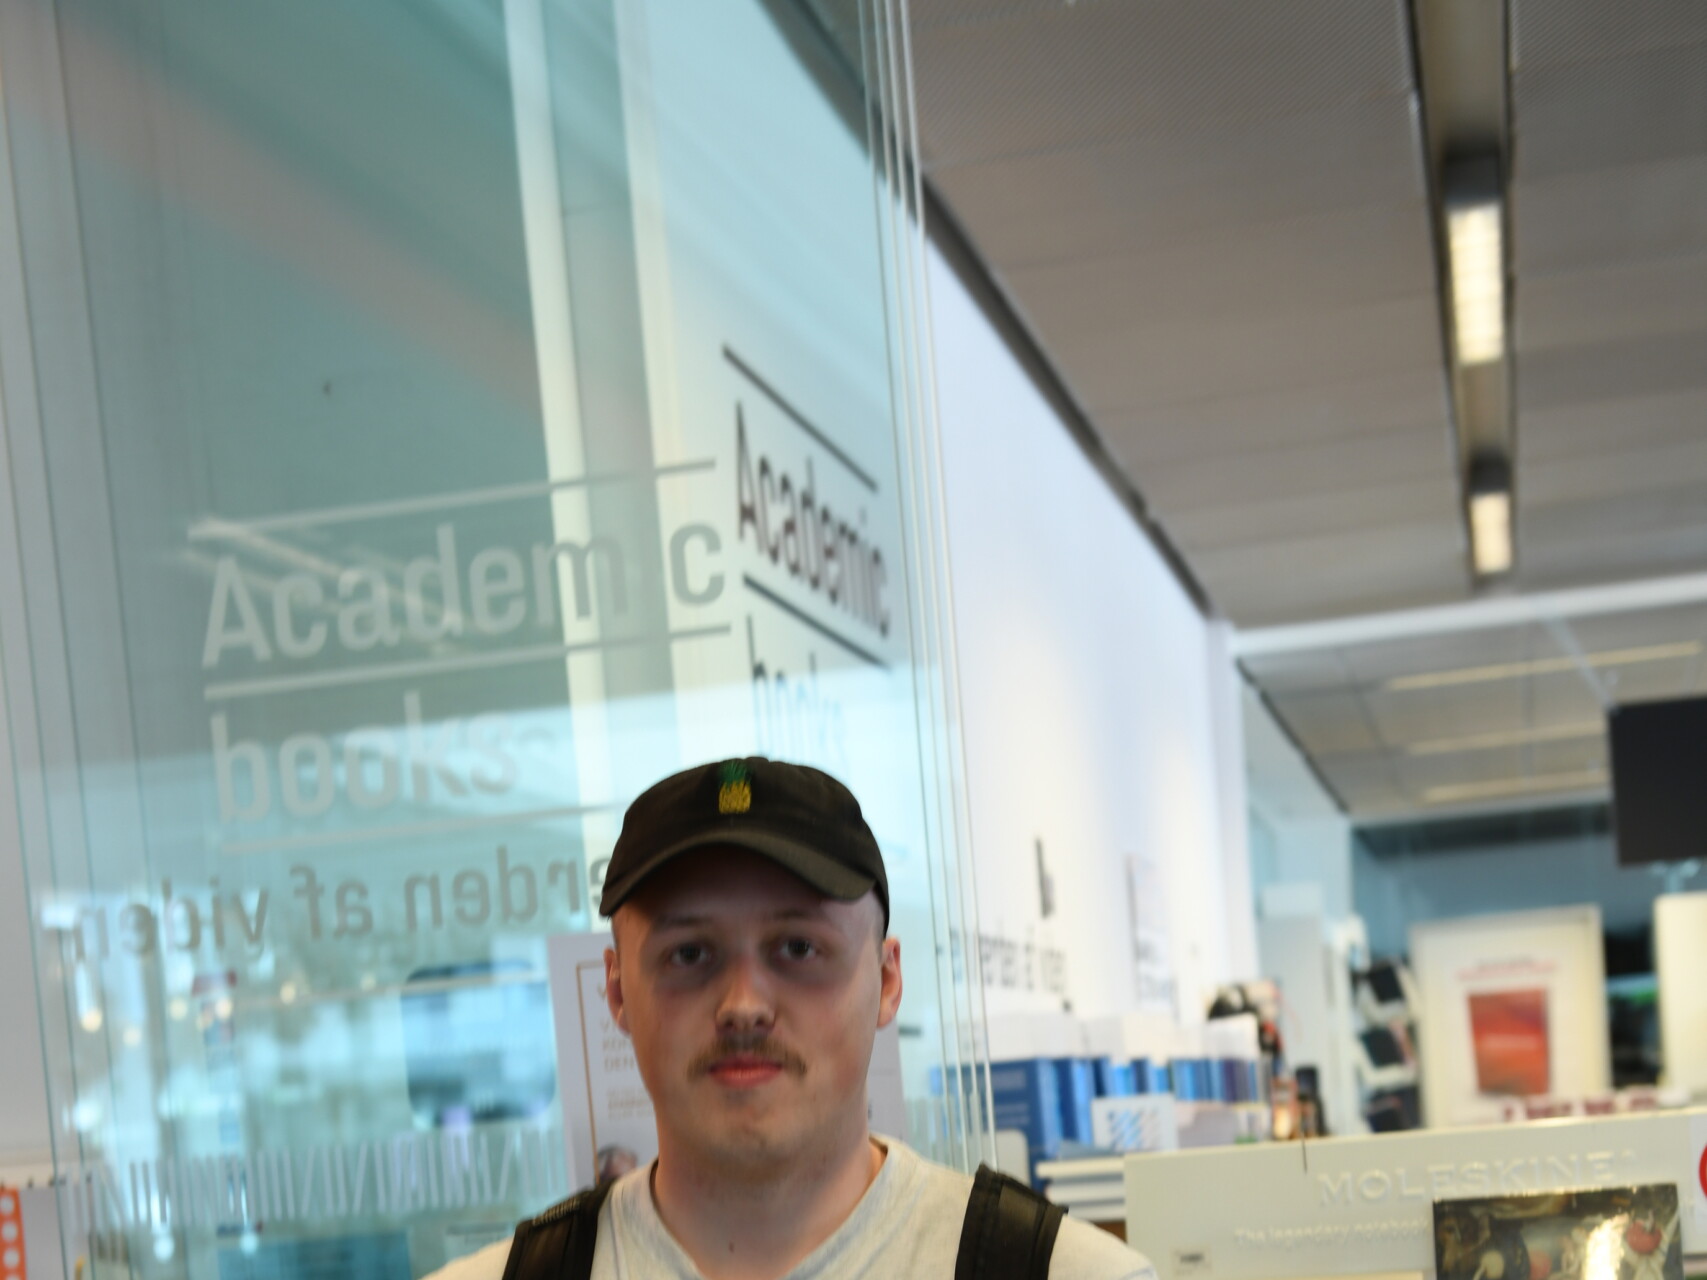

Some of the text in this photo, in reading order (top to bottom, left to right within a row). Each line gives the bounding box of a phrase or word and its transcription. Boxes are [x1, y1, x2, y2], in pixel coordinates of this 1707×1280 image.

[734, 399, 891, 640] Academic
[202, 521, 727, 669] Academc
[210, 687, 520, 824] books
[1318, 1149, 1617, 1205] MOLESKINE
